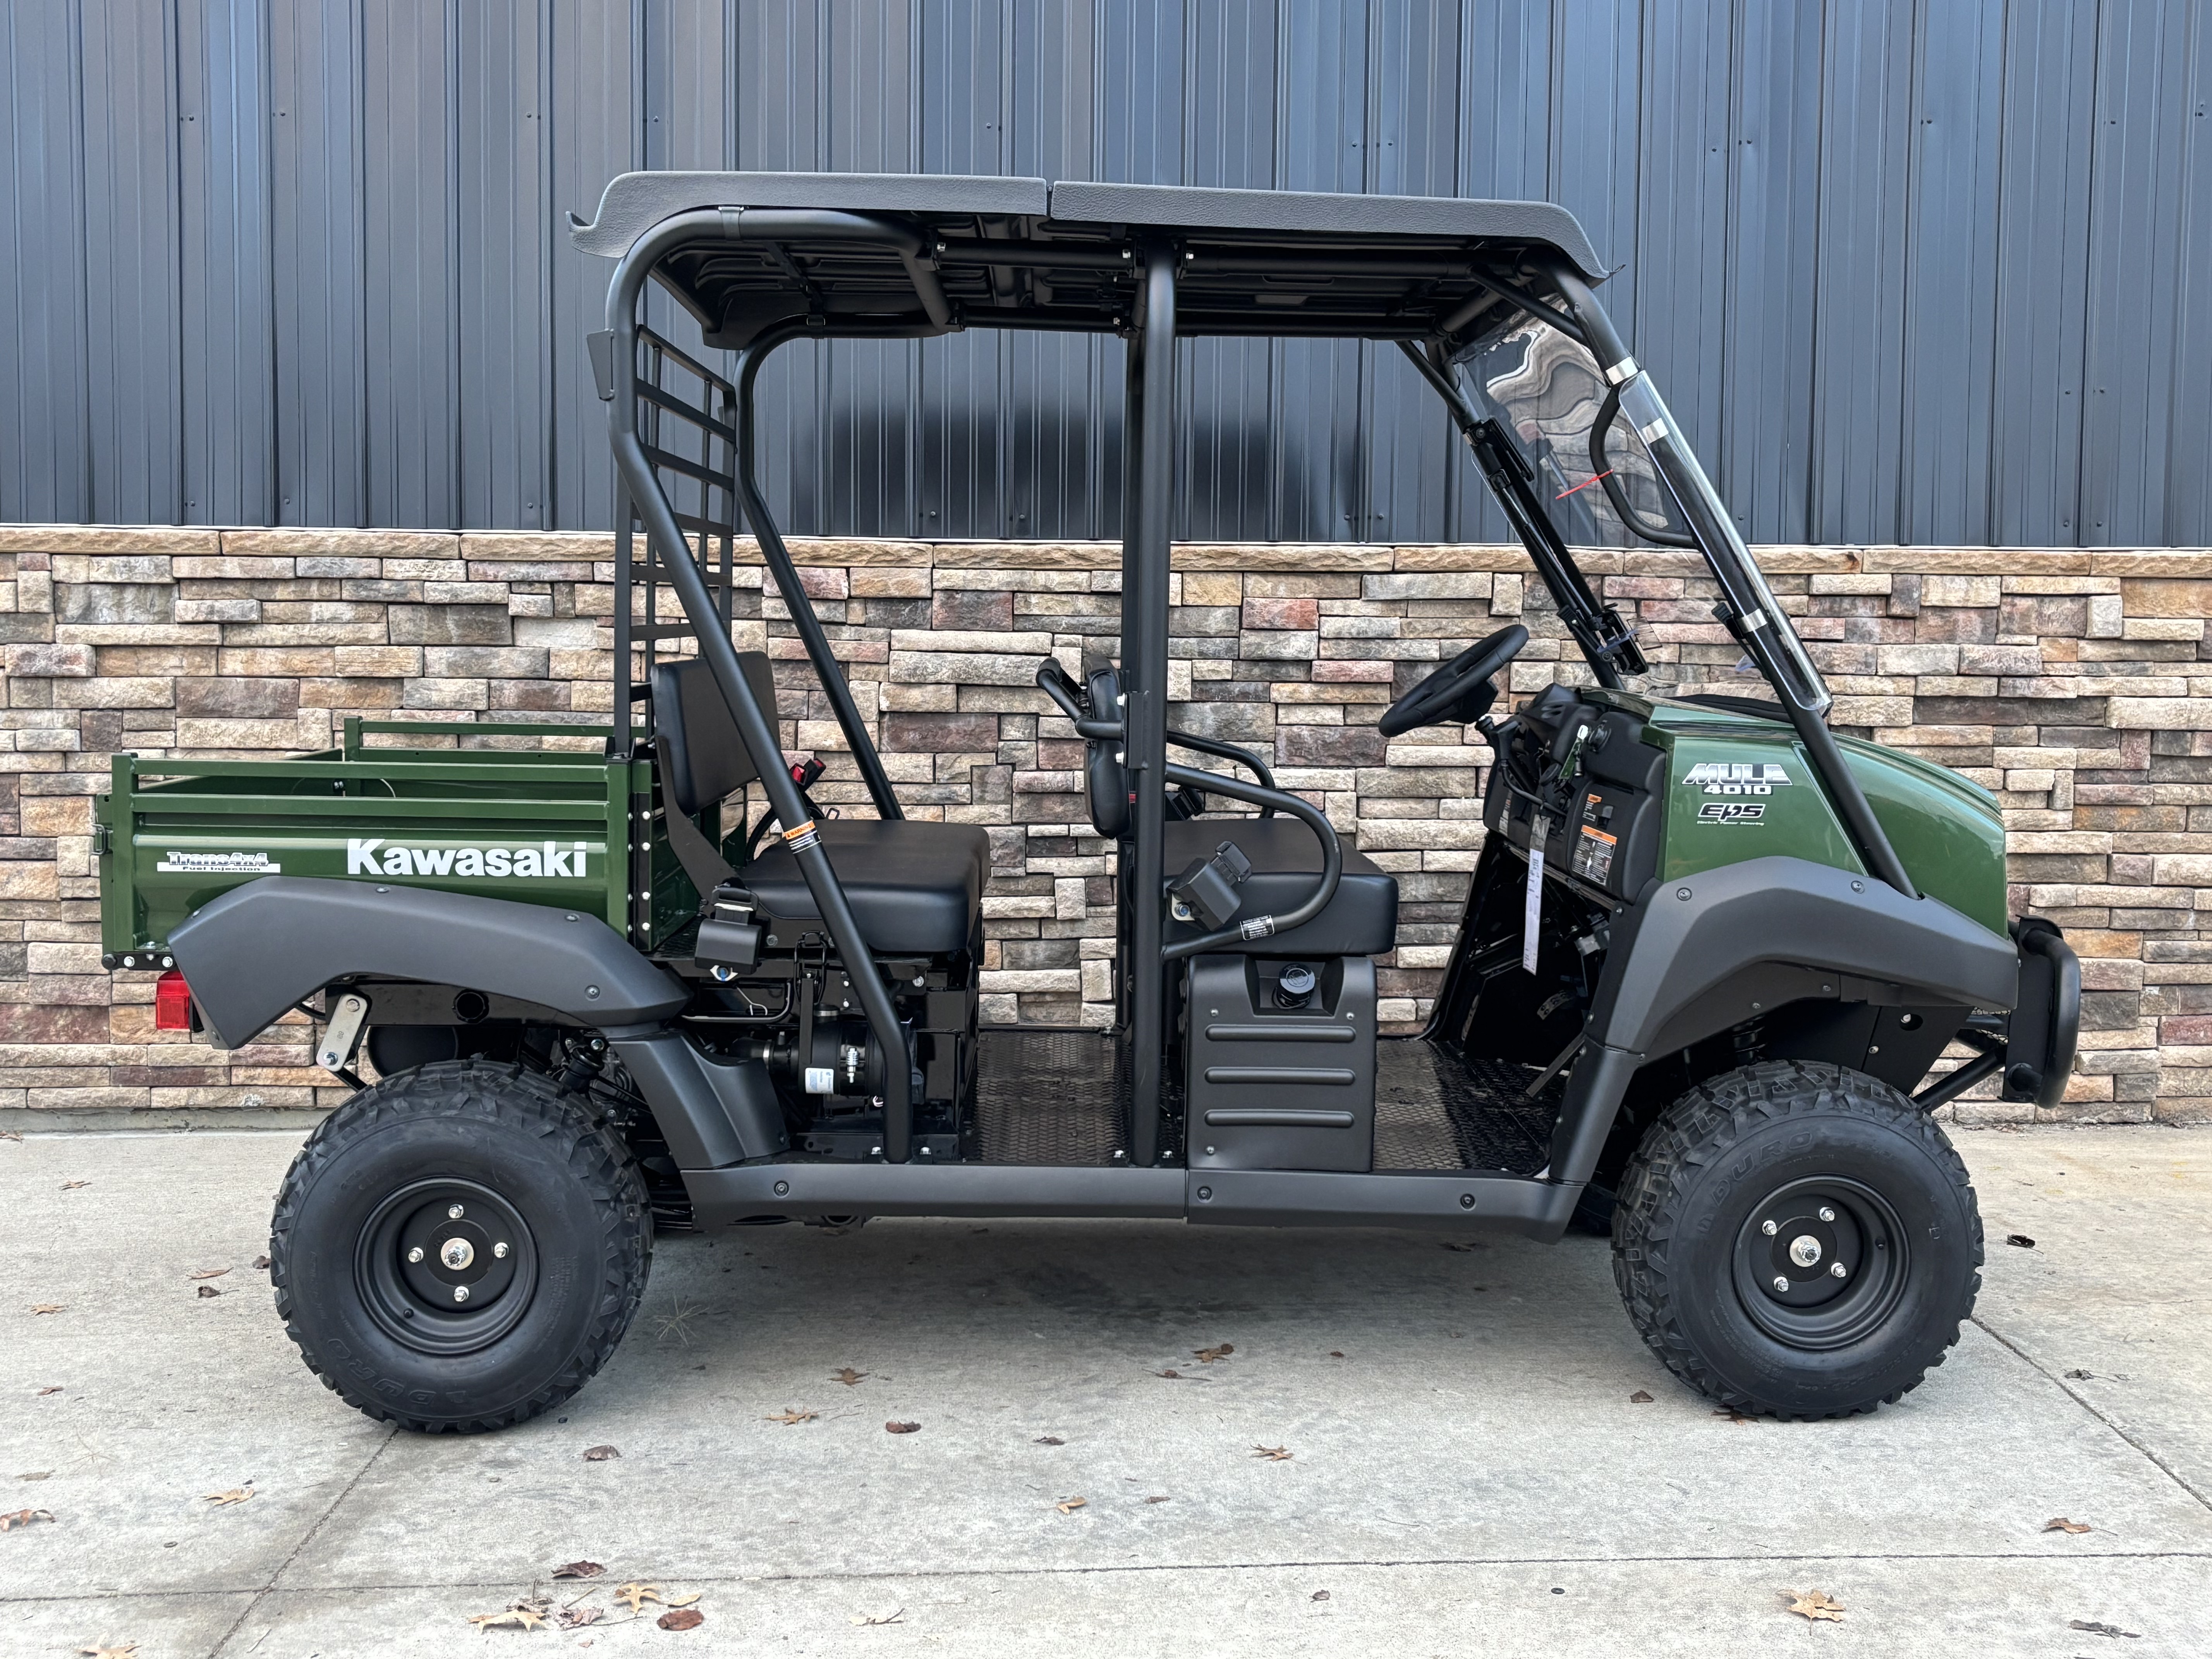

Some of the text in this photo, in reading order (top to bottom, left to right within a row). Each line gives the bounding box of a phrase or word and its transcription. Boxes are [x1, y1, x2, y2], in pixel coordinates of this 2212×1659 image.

[1681, 763, 1793, 786] MULE
[1704, 785, 1772, 795] 4010
[1698, 803, 1766, 821] EPS
[167, 852, 269, 866] Trans4x4
[347, 838, 587, 877] Kawasaki
[1711, 1131, 1812, 1206] DURO
[326, 1338, 437, 1405] DURO
